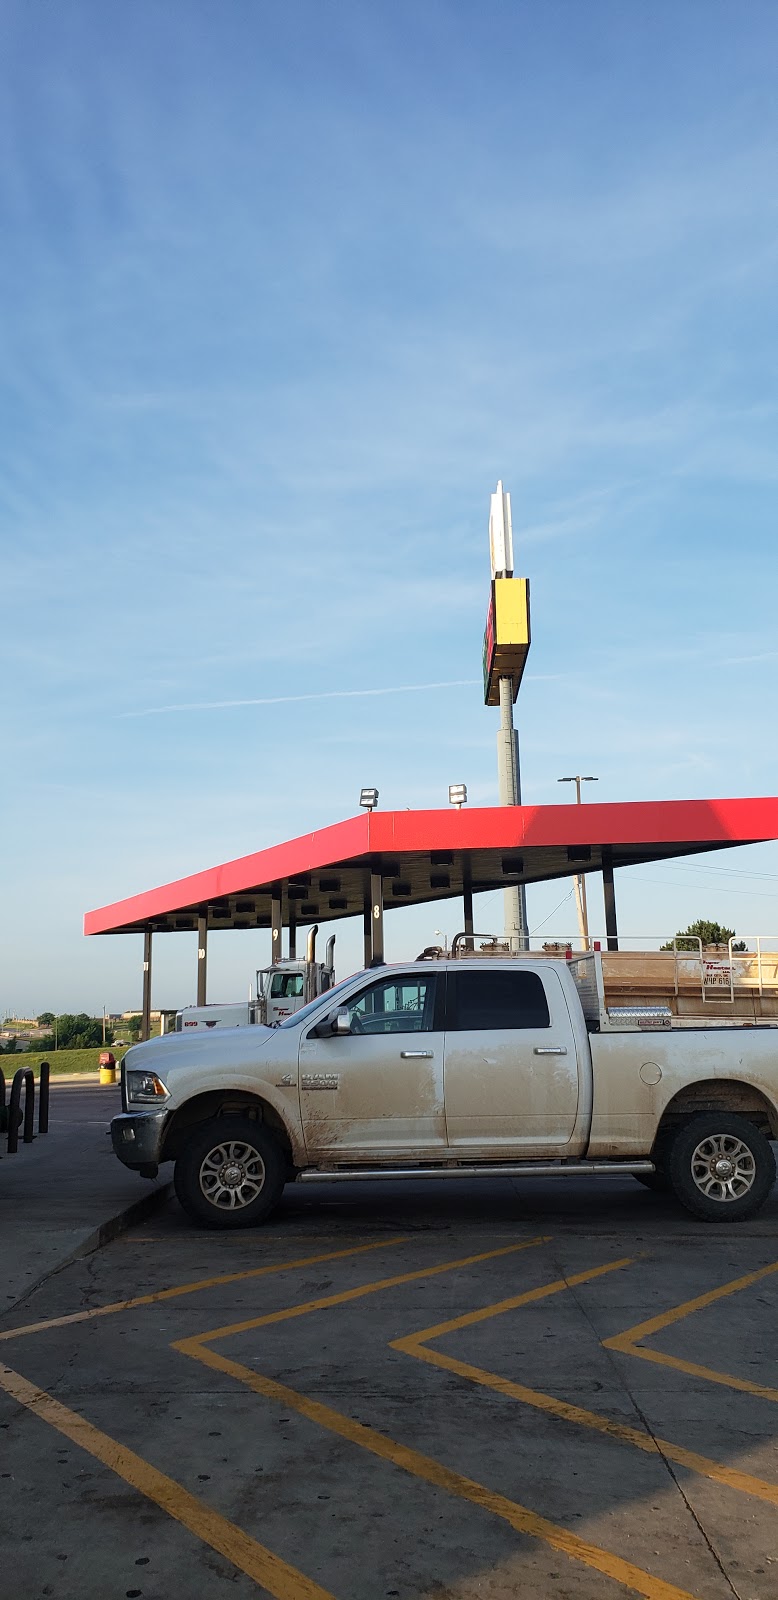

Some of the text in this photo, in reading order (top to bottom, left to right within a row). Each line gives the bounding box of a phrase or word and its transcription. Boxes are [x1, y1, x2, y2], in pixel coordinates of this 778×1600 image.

[373, 905, 380, 919] 8
[273, 929, 279, 941] 9
[198, 948, 206, 959] 10
[143, 961, 149, 971] 11
